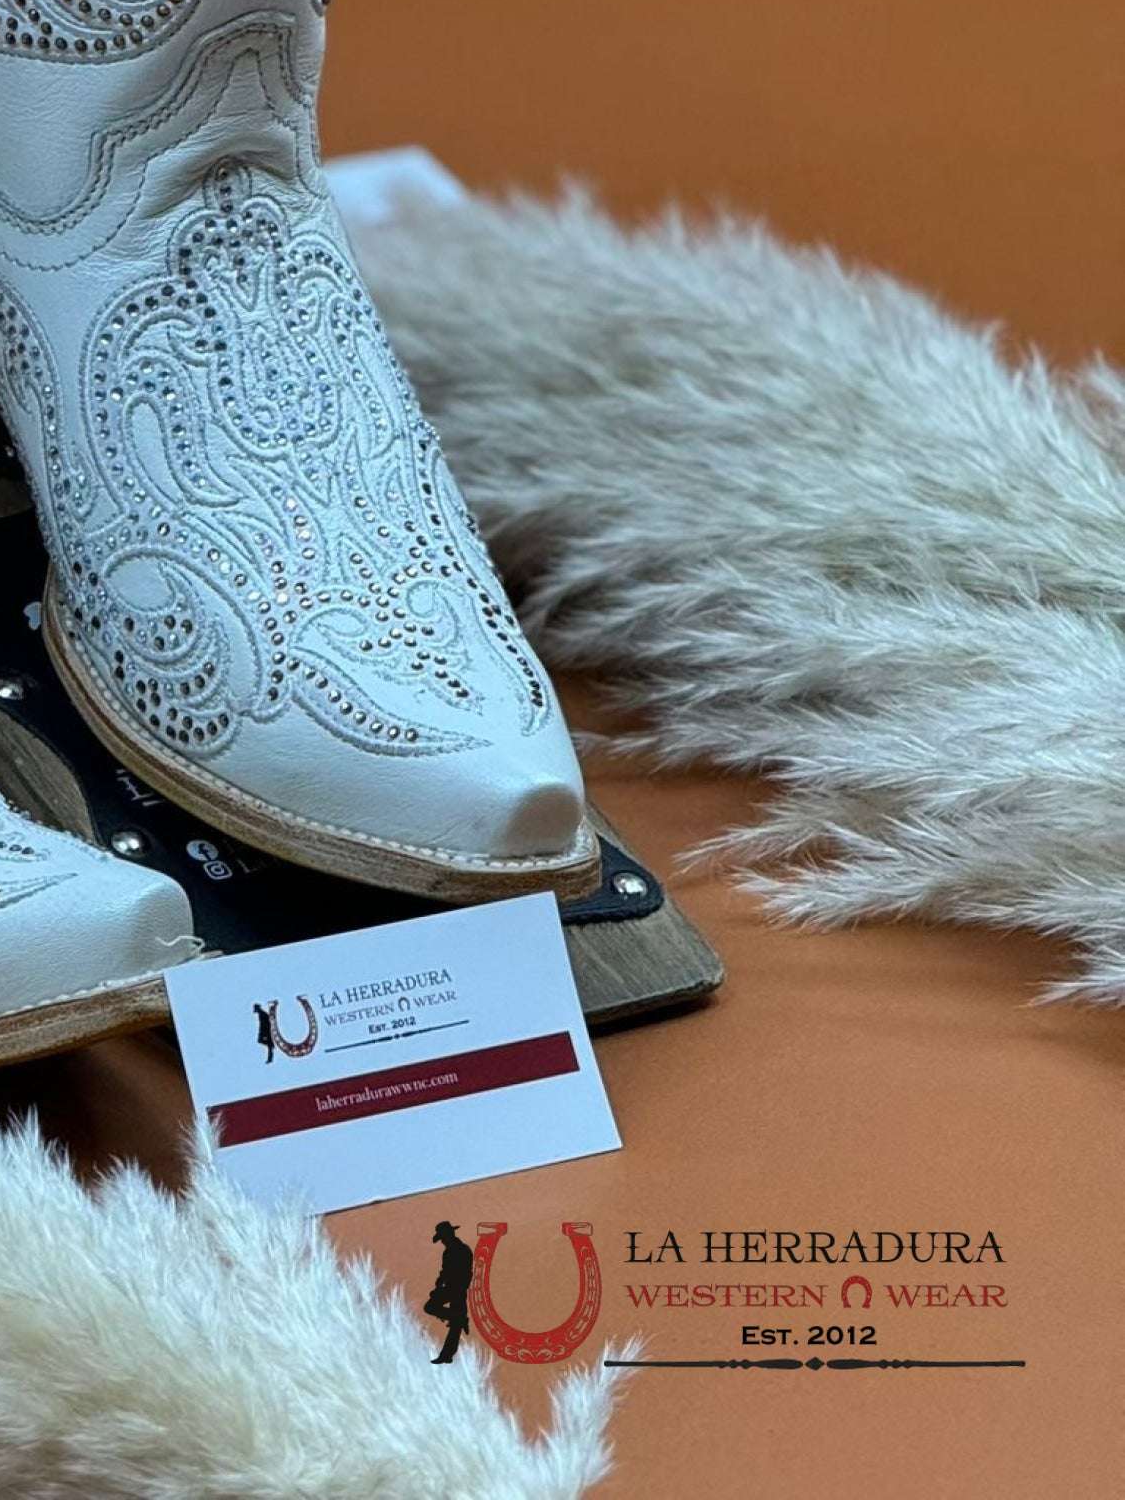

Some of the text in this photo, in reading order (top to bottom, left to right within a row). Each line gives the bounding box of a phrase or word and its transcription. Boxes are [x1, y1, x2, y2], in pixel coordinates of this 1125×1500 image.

[319, 969, 452, 1008] LA HERRADURA
[324, 990, 457, 1027] WESTERN WEAR
[392, 1016, 417, 1030] 2012
[315, 1072, 458, 1112] laherradurawwnc.com
